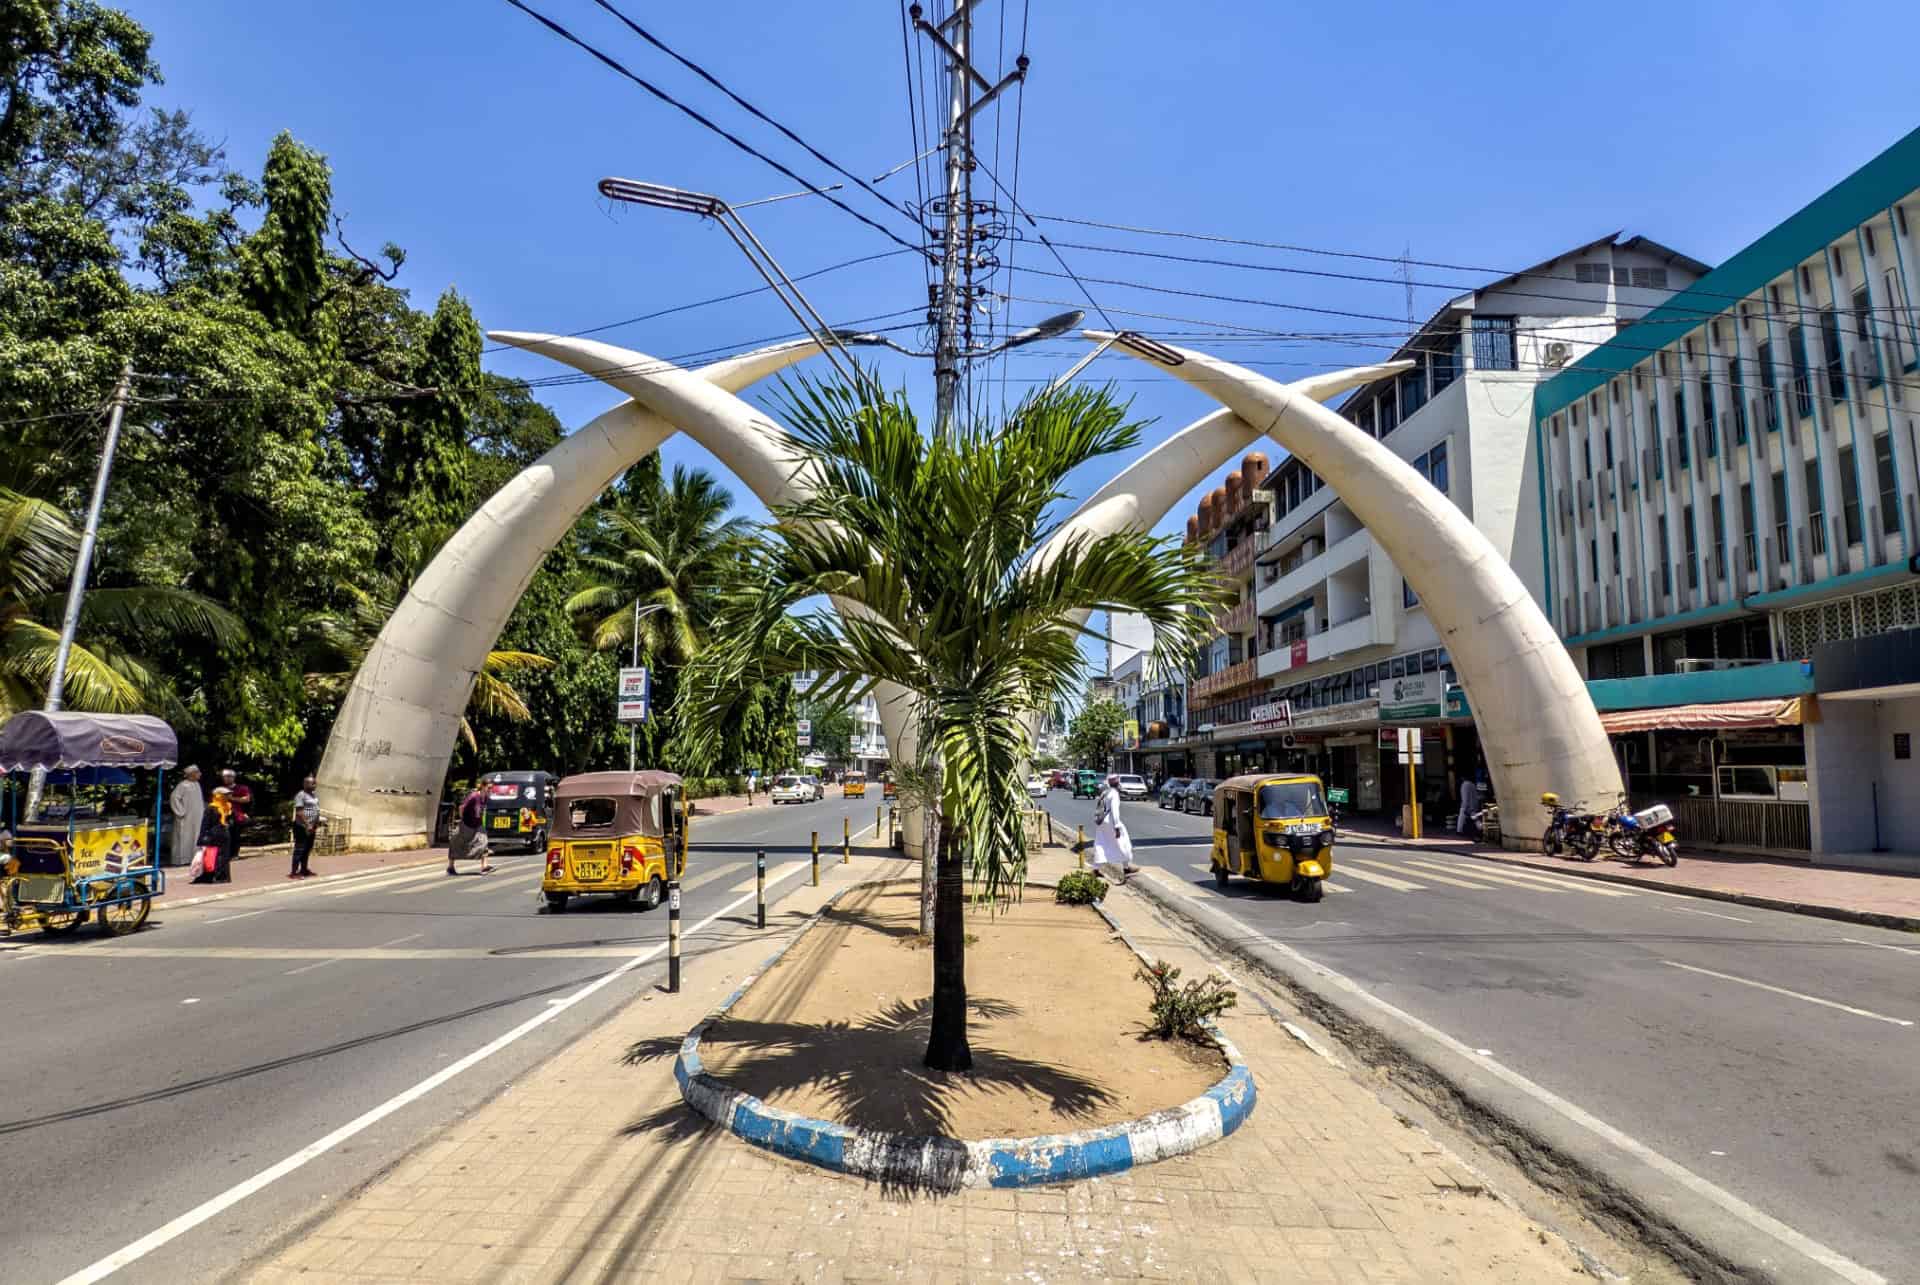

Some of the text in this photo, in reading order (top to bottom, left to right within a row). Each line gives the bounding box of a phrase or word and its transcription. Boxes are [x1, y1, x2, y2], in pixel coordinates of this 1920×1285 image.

[1250, 703, 1286, 721] CHEMIST
[81, 848, 93, 858] Ice
[74, 859, 100, 869] Cream
